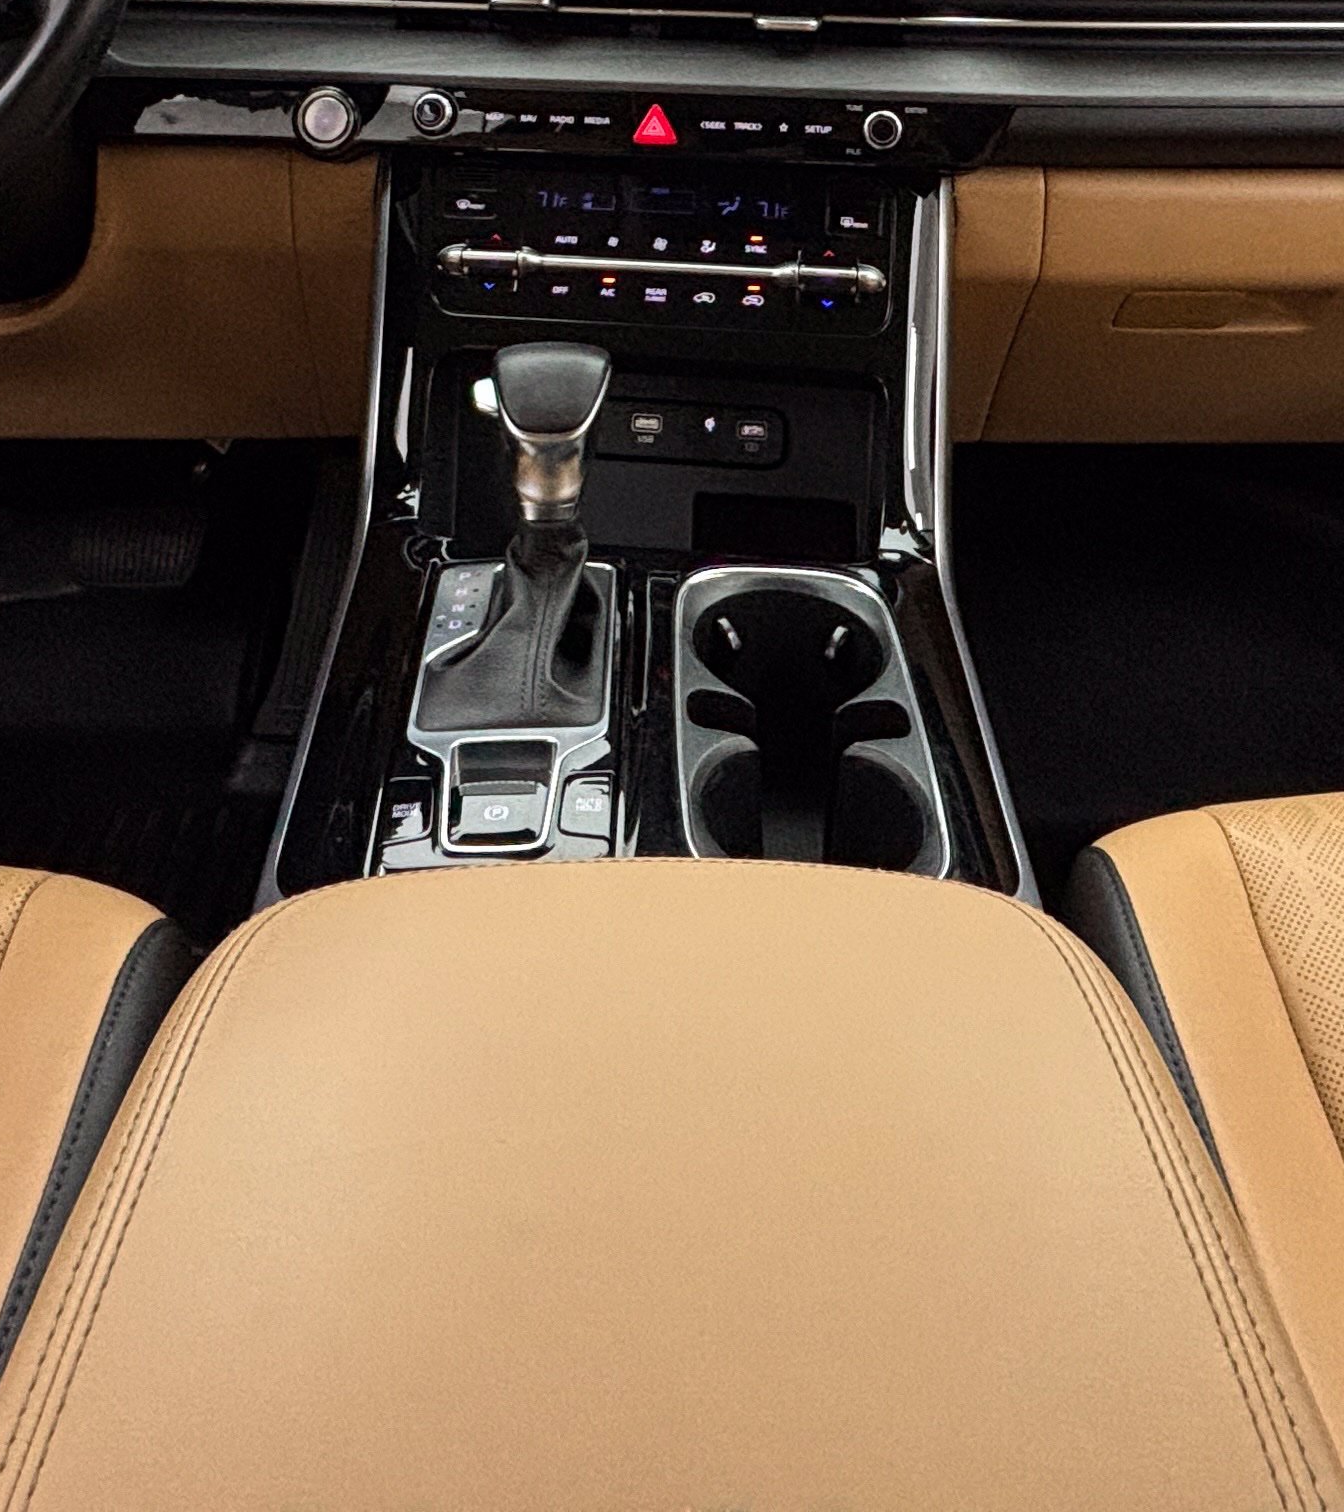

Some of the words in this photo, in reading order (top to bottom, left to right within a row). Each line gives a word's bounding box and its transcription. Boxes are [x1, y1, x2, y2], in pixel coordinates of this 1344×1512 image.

[549, 115, 575, 125] RADIO
[583, 116, 610, 125] MEDIA
[804, 125, 832, 134] SETUP
[555, 235, 578, 244] AUTO
[552, 286, 568, 294] OFF
